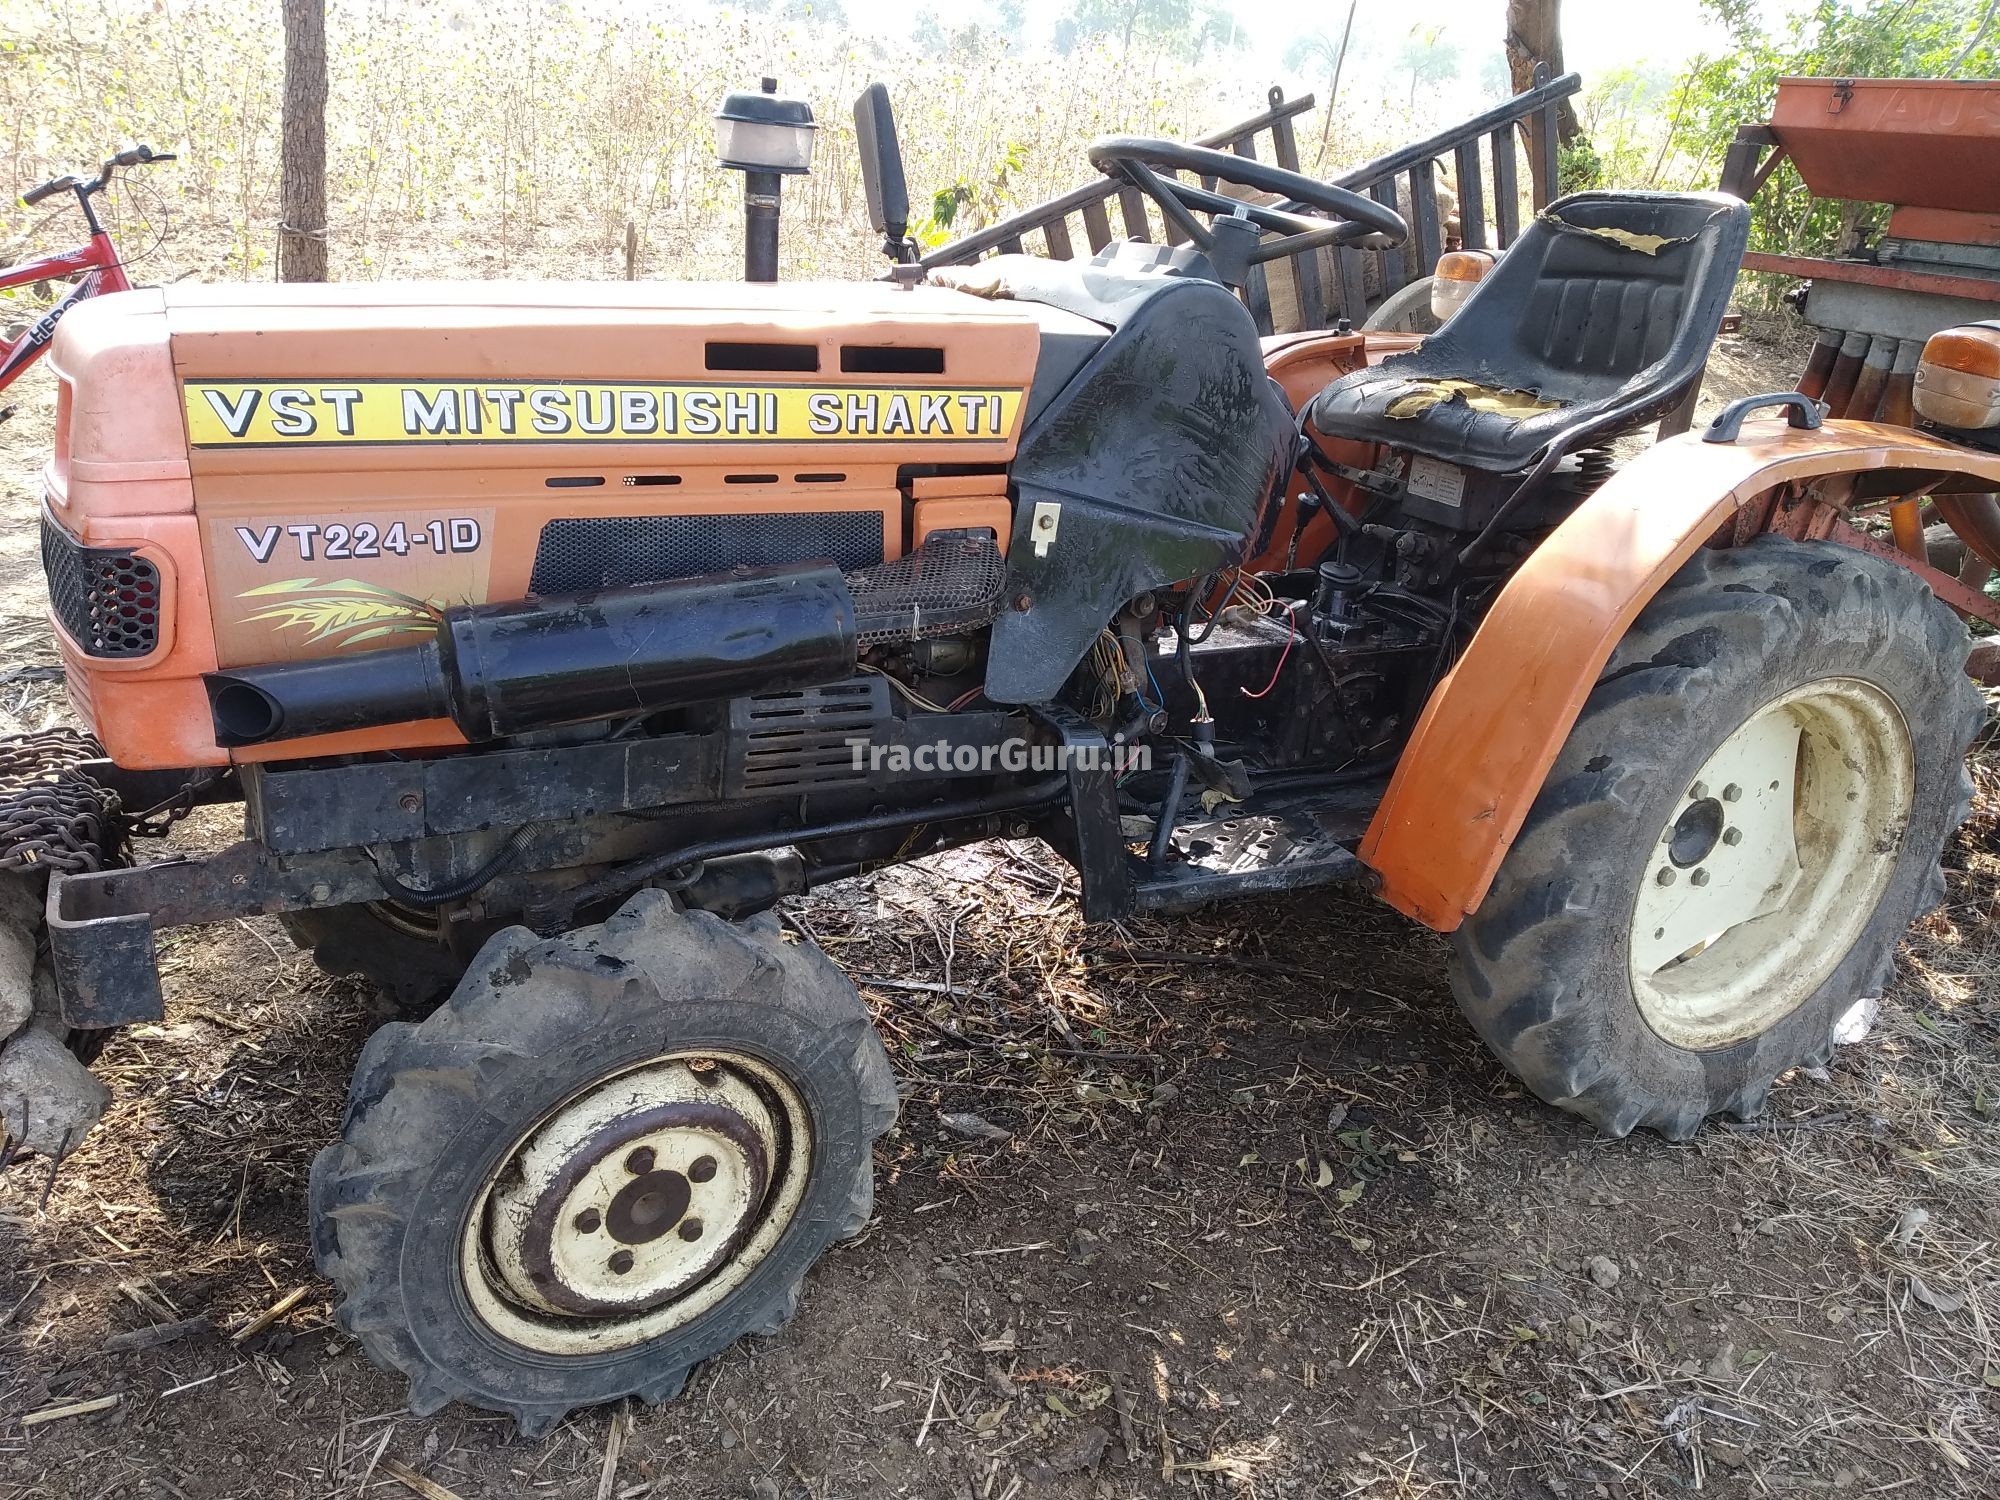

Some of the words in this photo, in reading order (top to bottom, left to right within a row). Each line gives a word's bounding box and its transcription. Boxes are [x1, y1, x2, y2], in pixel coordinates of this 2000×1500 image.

[201, 388, 363, 438] VST
[401, 388, 779, 435] MITSUBISHI
[808, 393, 1003, 436] SHAKTI
[235, 517, 482, 564] VT224-1D
